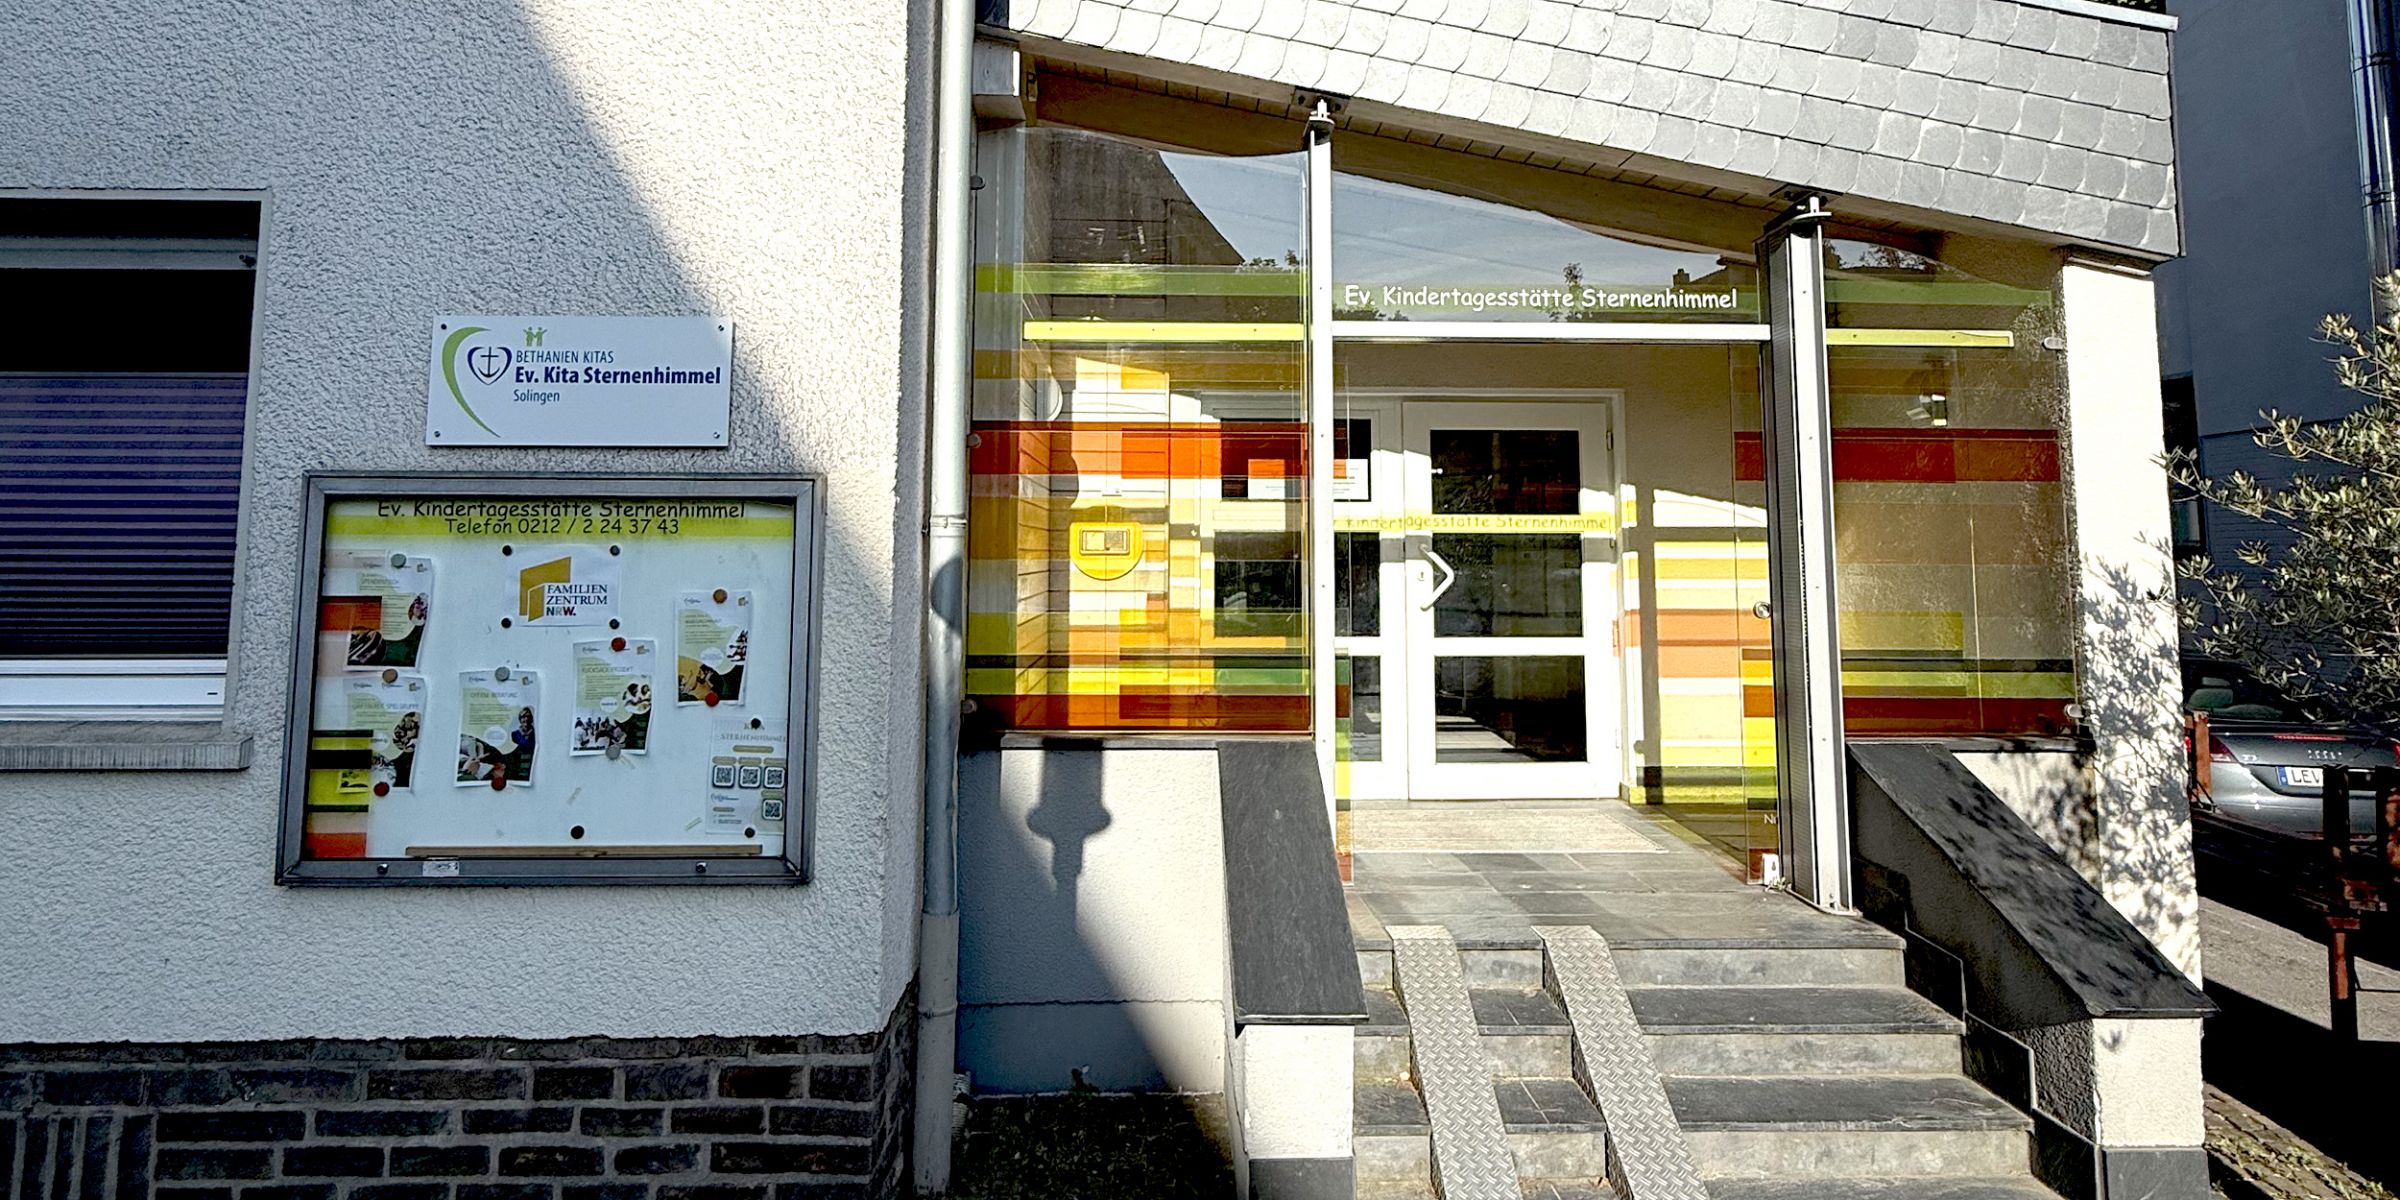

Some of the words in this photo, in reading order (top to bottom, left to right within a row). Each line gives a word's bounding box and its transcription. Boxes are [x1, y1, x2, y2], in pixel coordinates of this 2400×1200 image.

[1344, 285, 1375, 306] Ev.
[1383, 286, 1574, 312] Kindertagesstätte
[1581, 287, 1737, 310] Sternenhimmel
[516, 350, 579, 364] BETHANIEN
[583, 350, 614, 364] KITAS
[515, 367, 539, 384] Ev.
[544, 366, 579, 384] Kita
[584, 366, 721, 384] Sternenhimmel
[513, 388, 560, 406] Solingen
[378, 502, 404, 517] Ev.
[413, 501, 592, 521] Kindertagesstätte
[599, 501, 745, 518] Sternenhimmel
[445, 518, 513, 534] Telefon
[518, 518, 560, 534] 0212
[566, 518, 577, 535] /
[582, 518, 593, 534] 2
[600, 518, 622, 534] 24
[628, 518, 651, 534] 37
[656, 518, 679, 534] 43
[547, 584, 608, 595] FAMILIEN
[546, 595, 608, 605] ZENTRUM
